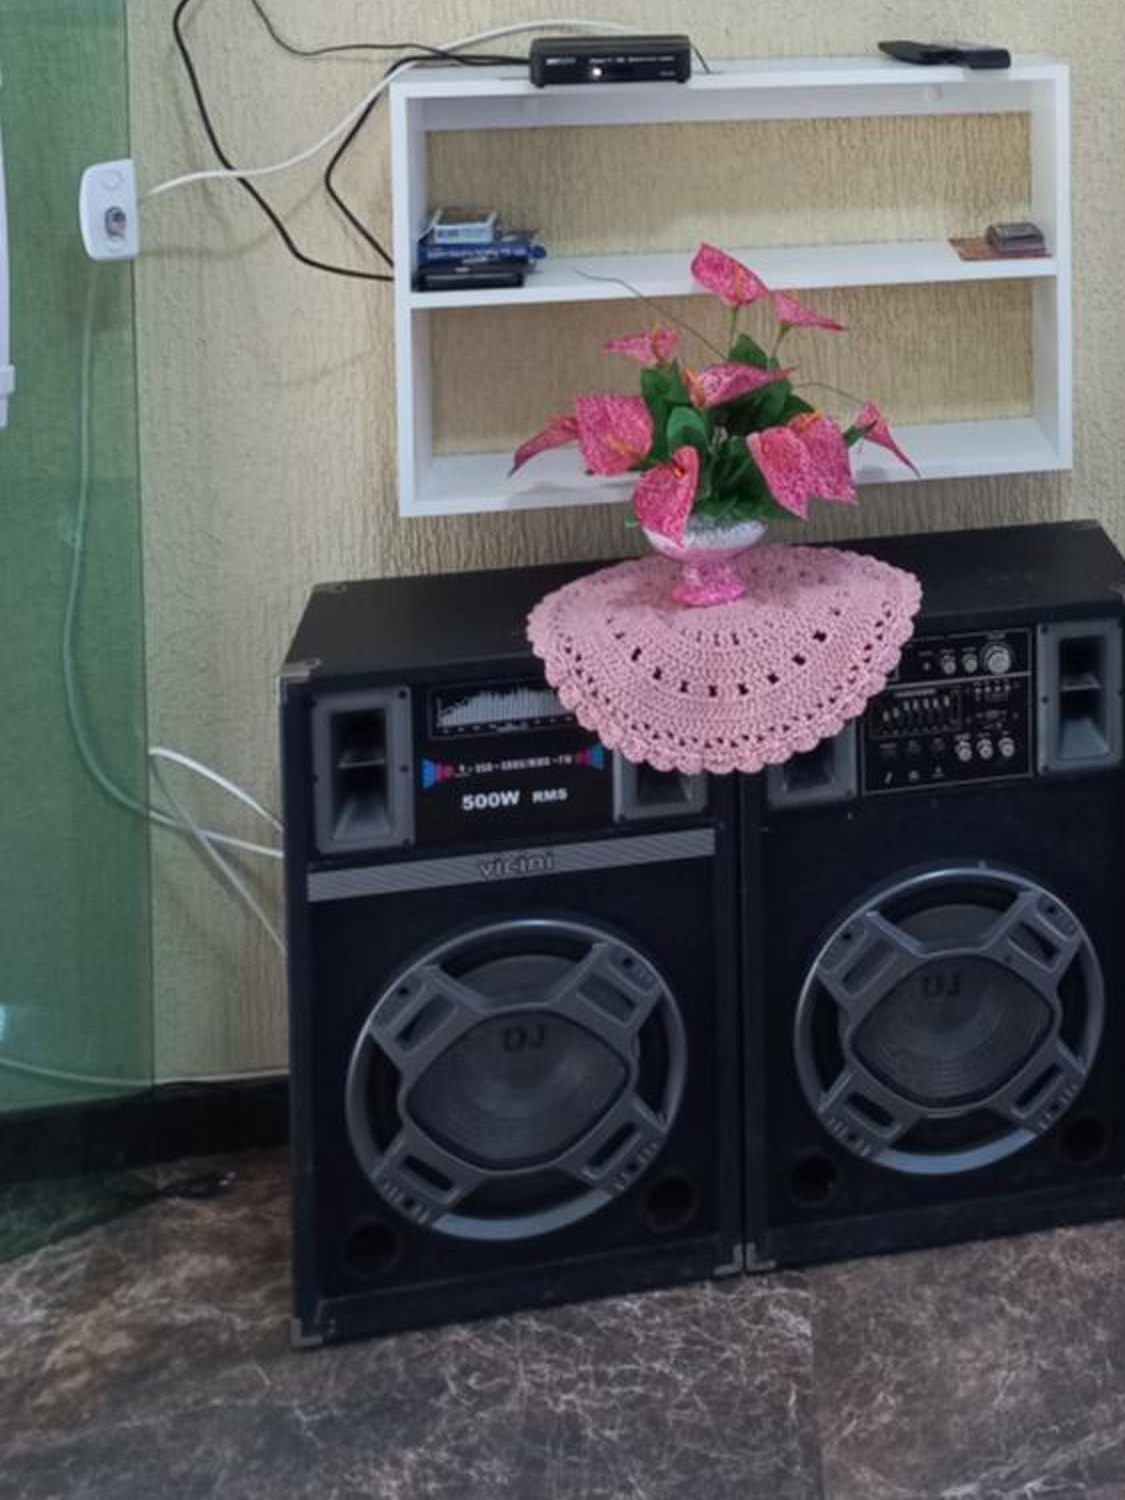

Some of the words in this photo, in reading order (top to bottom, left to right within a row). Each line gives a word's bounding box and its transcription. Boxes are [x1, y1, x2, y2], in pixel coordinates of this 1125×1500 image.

[461, 789, 521, 811] 500W
[531, 787, 568, 804] RMS
[503, 1024, 546, 1053] DJ
